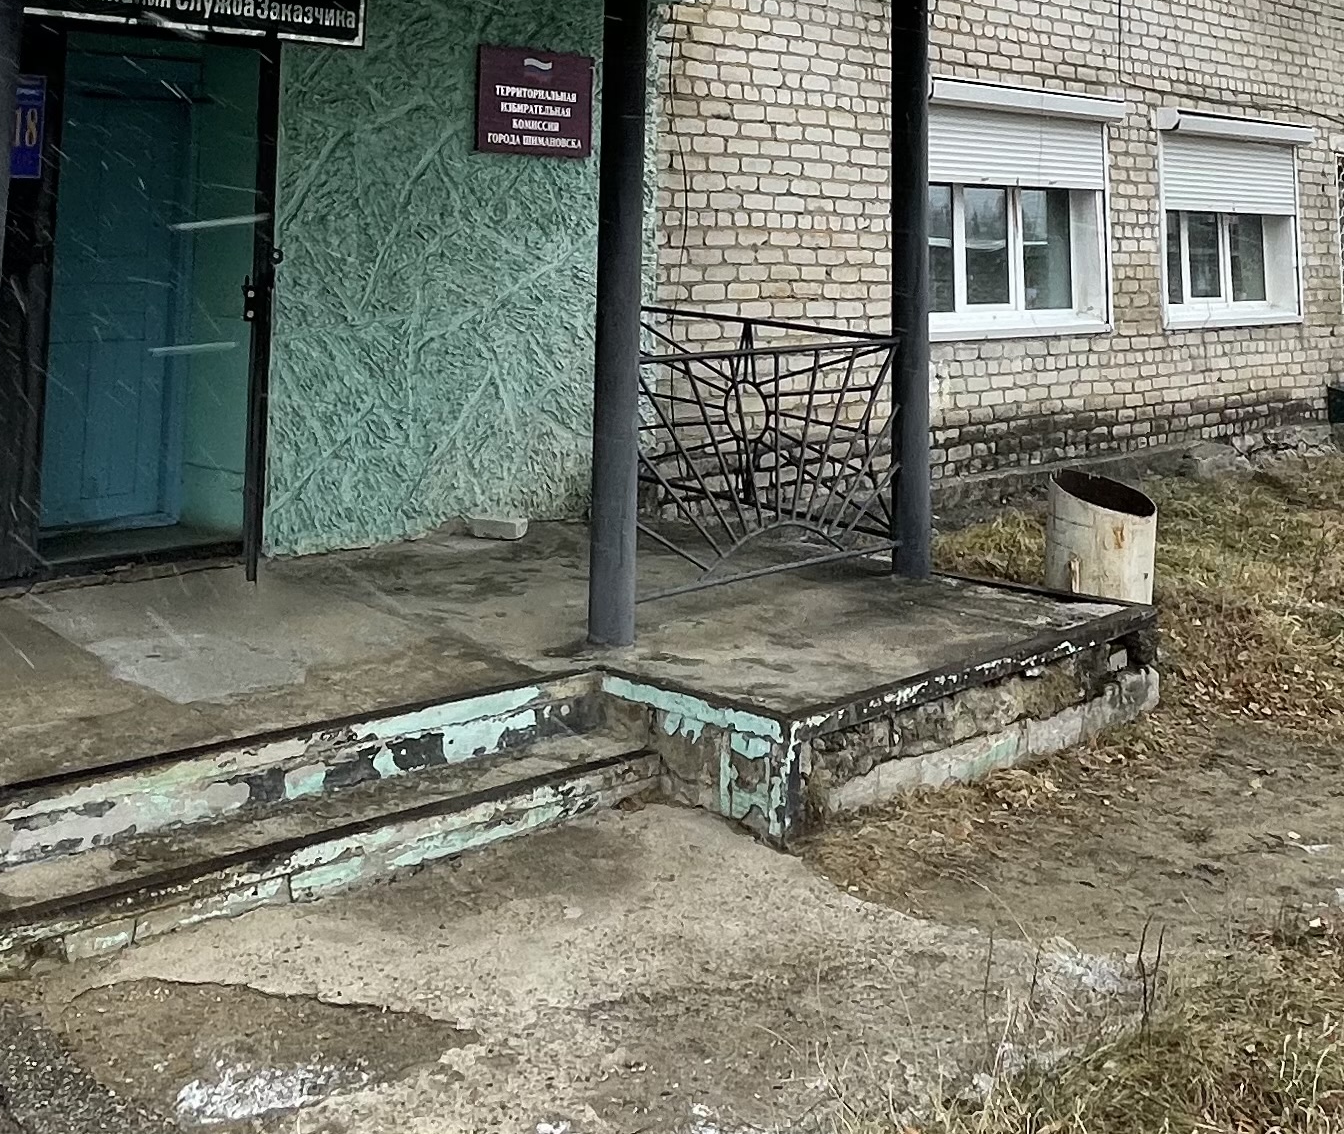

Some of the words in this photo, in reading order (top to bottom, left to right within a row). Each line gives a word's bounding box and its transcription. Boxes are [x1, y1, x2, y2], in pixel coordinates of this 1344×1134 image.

[496, 85, 576, 102] ТЕРРИТОРИАЛЬНАЯ
[500, 102, 571, 117] ИЗБИРАТЕЛЬНАЯ
[512, 119, 559, 132] КОМИССИЯ
[488, 133, 520, 145] ГОРОДА
[523, 135, 581, 149] ШИМАНОВСКА
